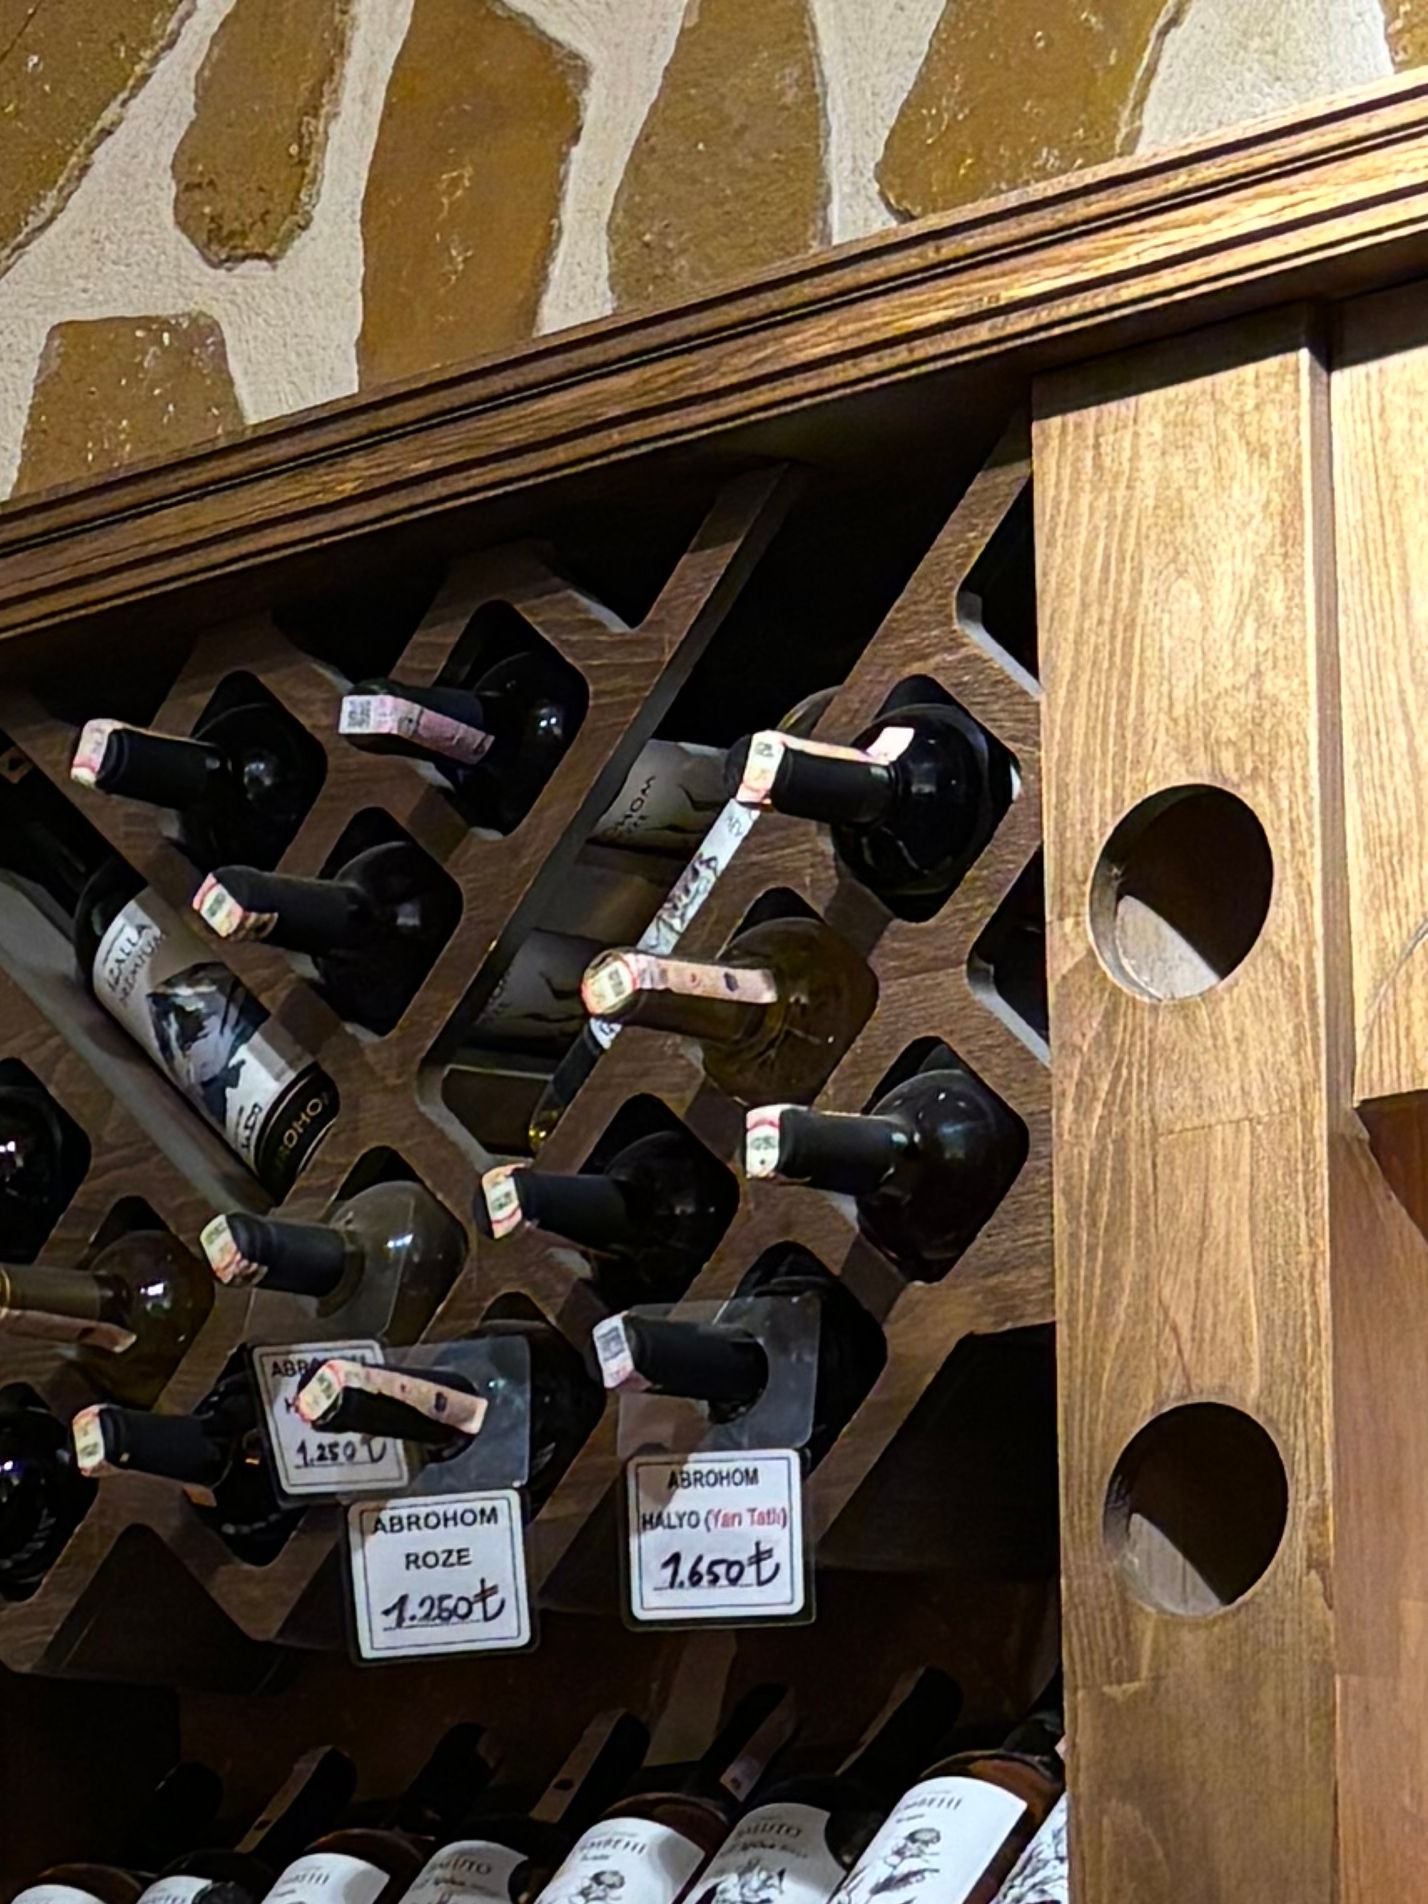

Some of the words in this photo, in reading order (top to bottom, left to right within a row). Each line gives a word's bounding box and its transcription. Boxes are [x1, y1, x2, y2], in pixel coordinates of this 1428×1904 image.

[668, 1467, 760, 1490] ABROHOM
[373, 1506, 498, 1534] ABROHOM
[642, 1510, 701, 1531] HALYO
[404, 1547, 473, 1571] ROZE
